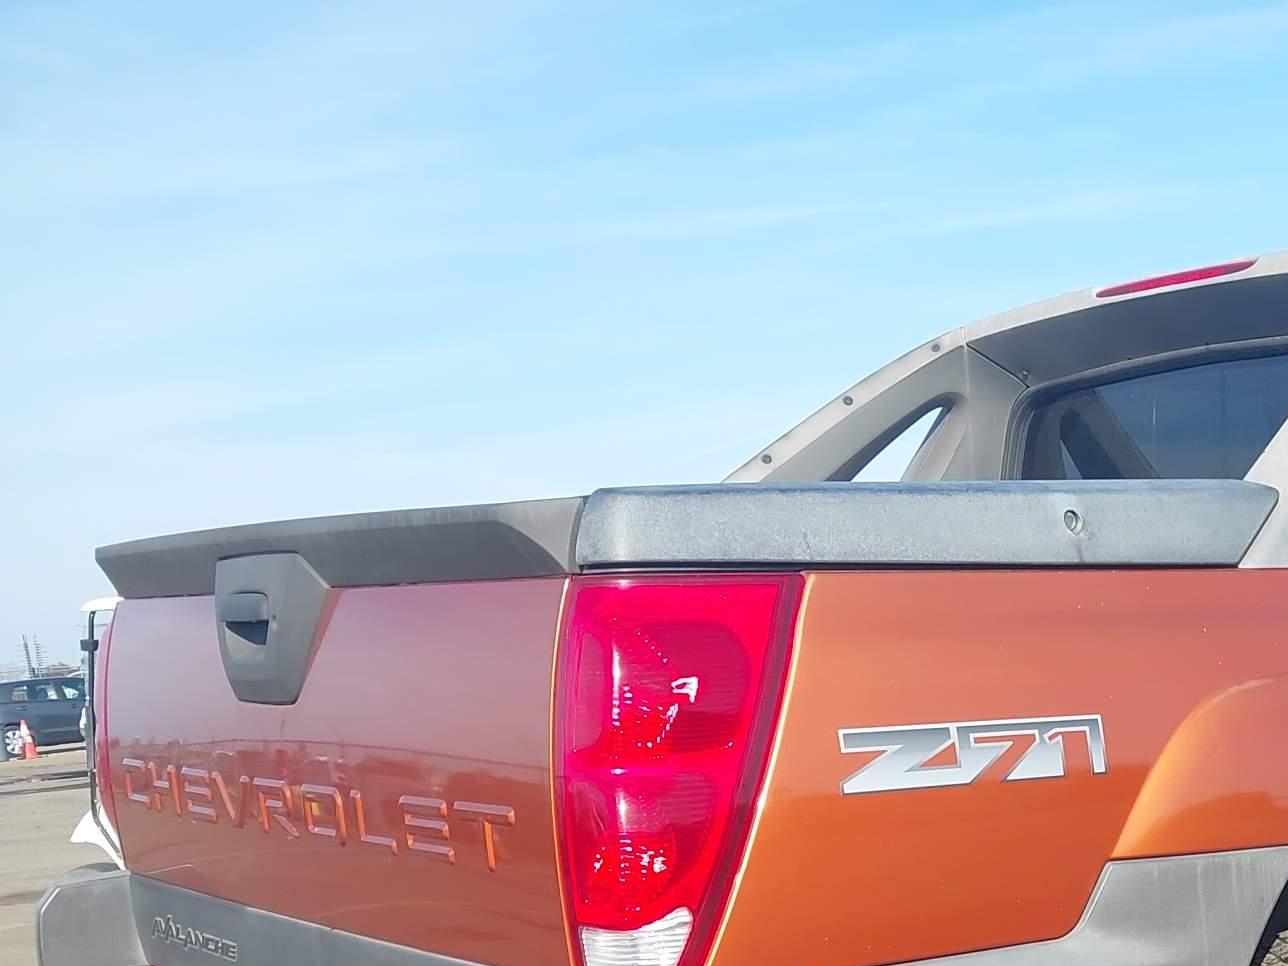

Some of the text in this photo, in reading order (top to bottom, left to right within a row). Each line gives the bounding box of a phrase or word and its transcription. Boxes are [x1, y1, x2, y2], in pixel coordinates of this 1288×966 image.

[837, 713, 1107, 795] Z71
[121, 757, 517, 873] CHEVROLET
[151, 914, 238, 962] AVALANCHE
